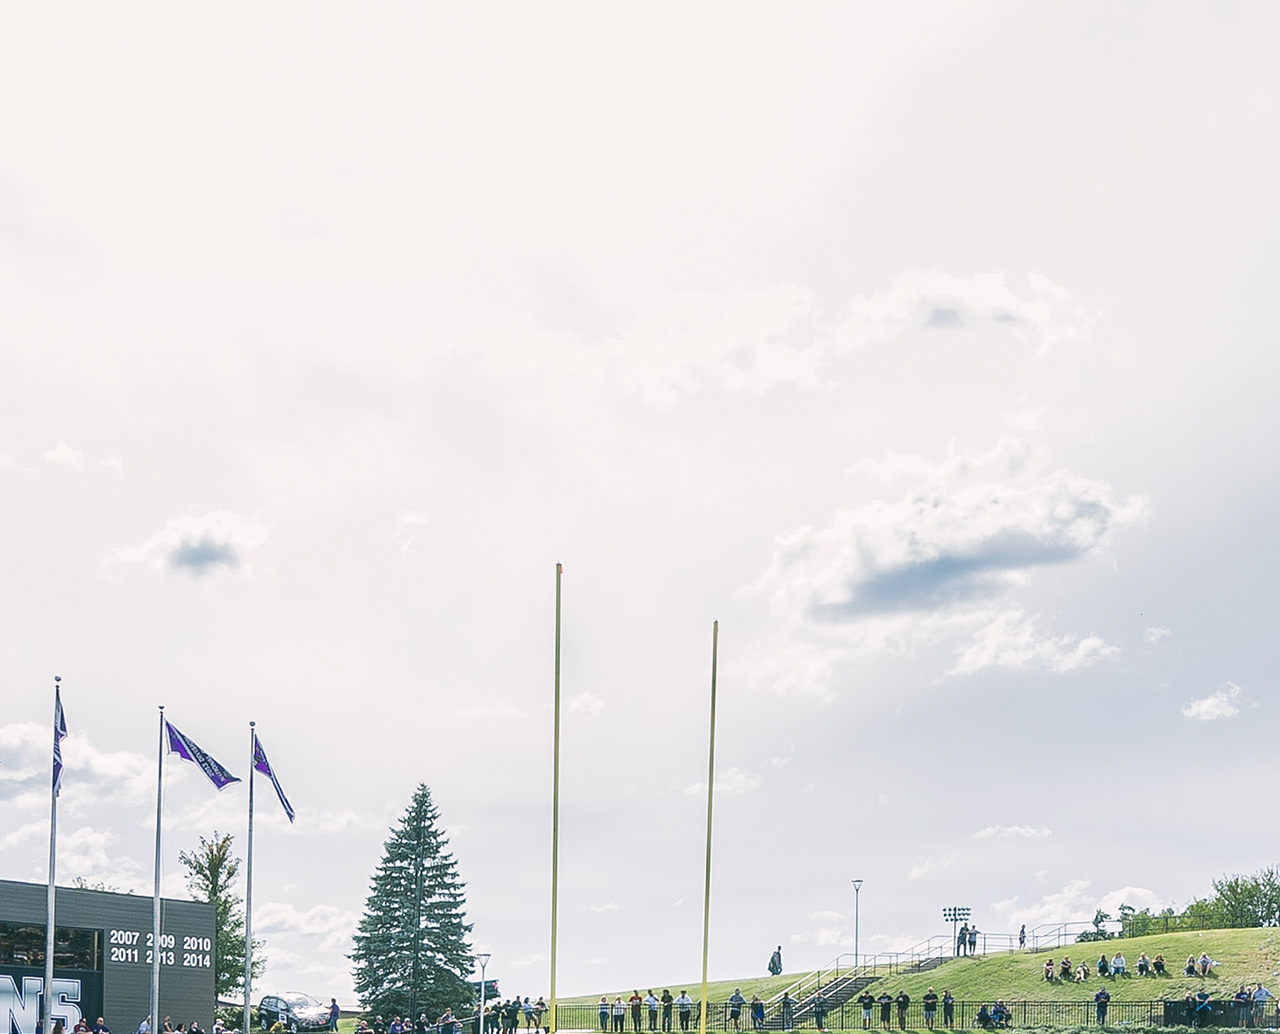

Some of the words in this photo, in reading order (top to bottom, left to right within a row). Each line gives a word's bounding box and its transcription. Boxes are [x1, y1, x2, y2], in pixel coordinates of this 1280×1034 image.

[109, 929, 140, 945] 2007
[145, 932, 175, 949] 209
[182, 936, 211, 951] 2010
[110, 947, 139, 962] 2011
[145, 950, 175, 965] 213
[182, 953, 211, 968] 2014
